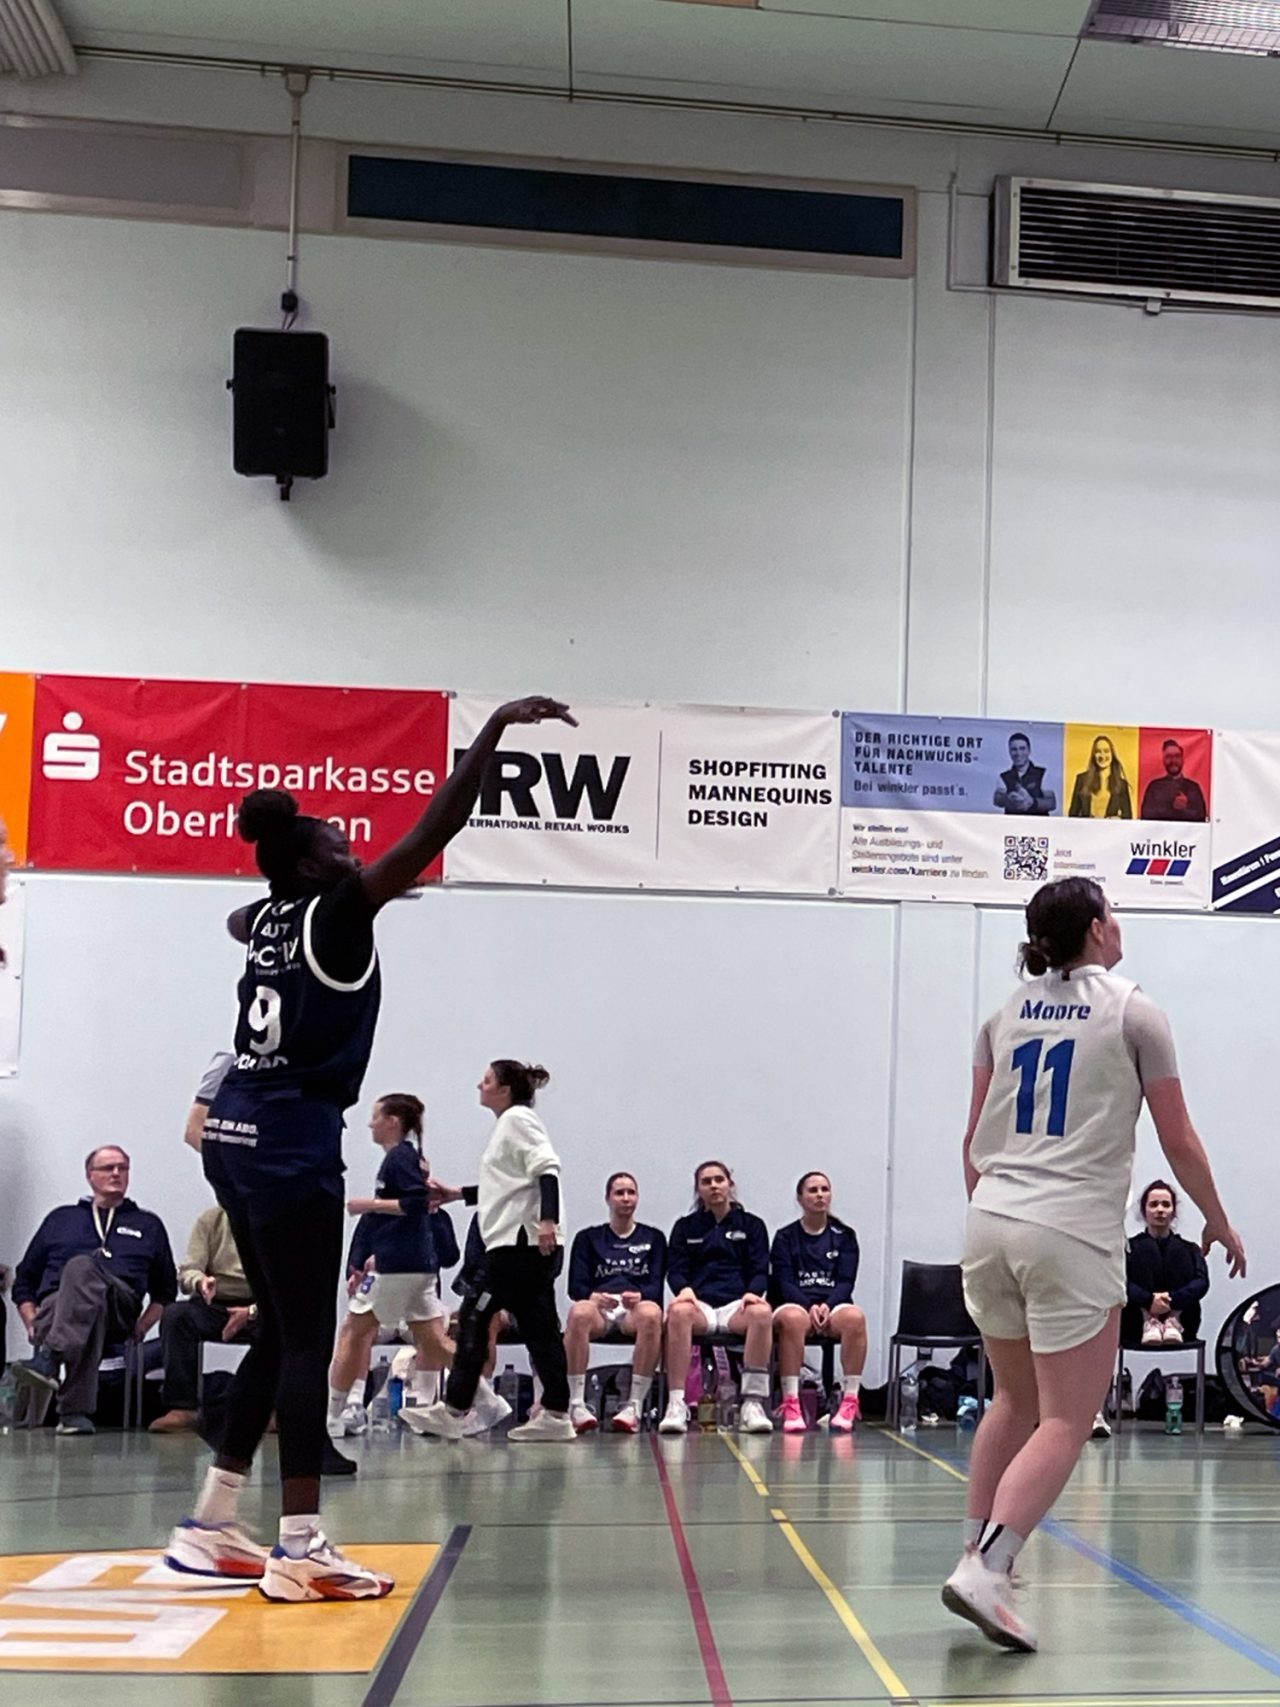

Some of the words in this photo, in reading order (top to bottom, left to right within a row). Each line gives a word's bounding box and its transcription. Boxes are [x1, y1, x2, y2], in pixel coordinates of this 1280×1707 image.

[855, 732, 881, 744] DER
[888, 733, 950, 747] RICHTIGE
[957, 736, 983, 748] ORT
[855, 745, 880, 758] FÜR
[887, 748, 978, 763] NACHWUCHS-
[124, 750, 436, 795] Stadtsparkasse
[688, 759, 827, 780] SHOPFITTING
[855, 761, 913, 776] TALENTE
[454, 748, 631, 820] RW
[854, 780, 873, 792] Bei
[877, 782, 919, 793] winkler
[688, 785, 832, 805] MANNEQUINS
[123, 801, 372, 843] Oberhn
[544, 821, 584, 832] RETAIL
[587, 824, 630, 834] WORKS
[688, 810, 768, 828] DESIGN
[1130, 839, 1196, 858] winkler
[248, 985, 282, 1055] 9
[1020, 999, 1091, 1021] Moore
[1011, 1038, 1076, 1137] 11
